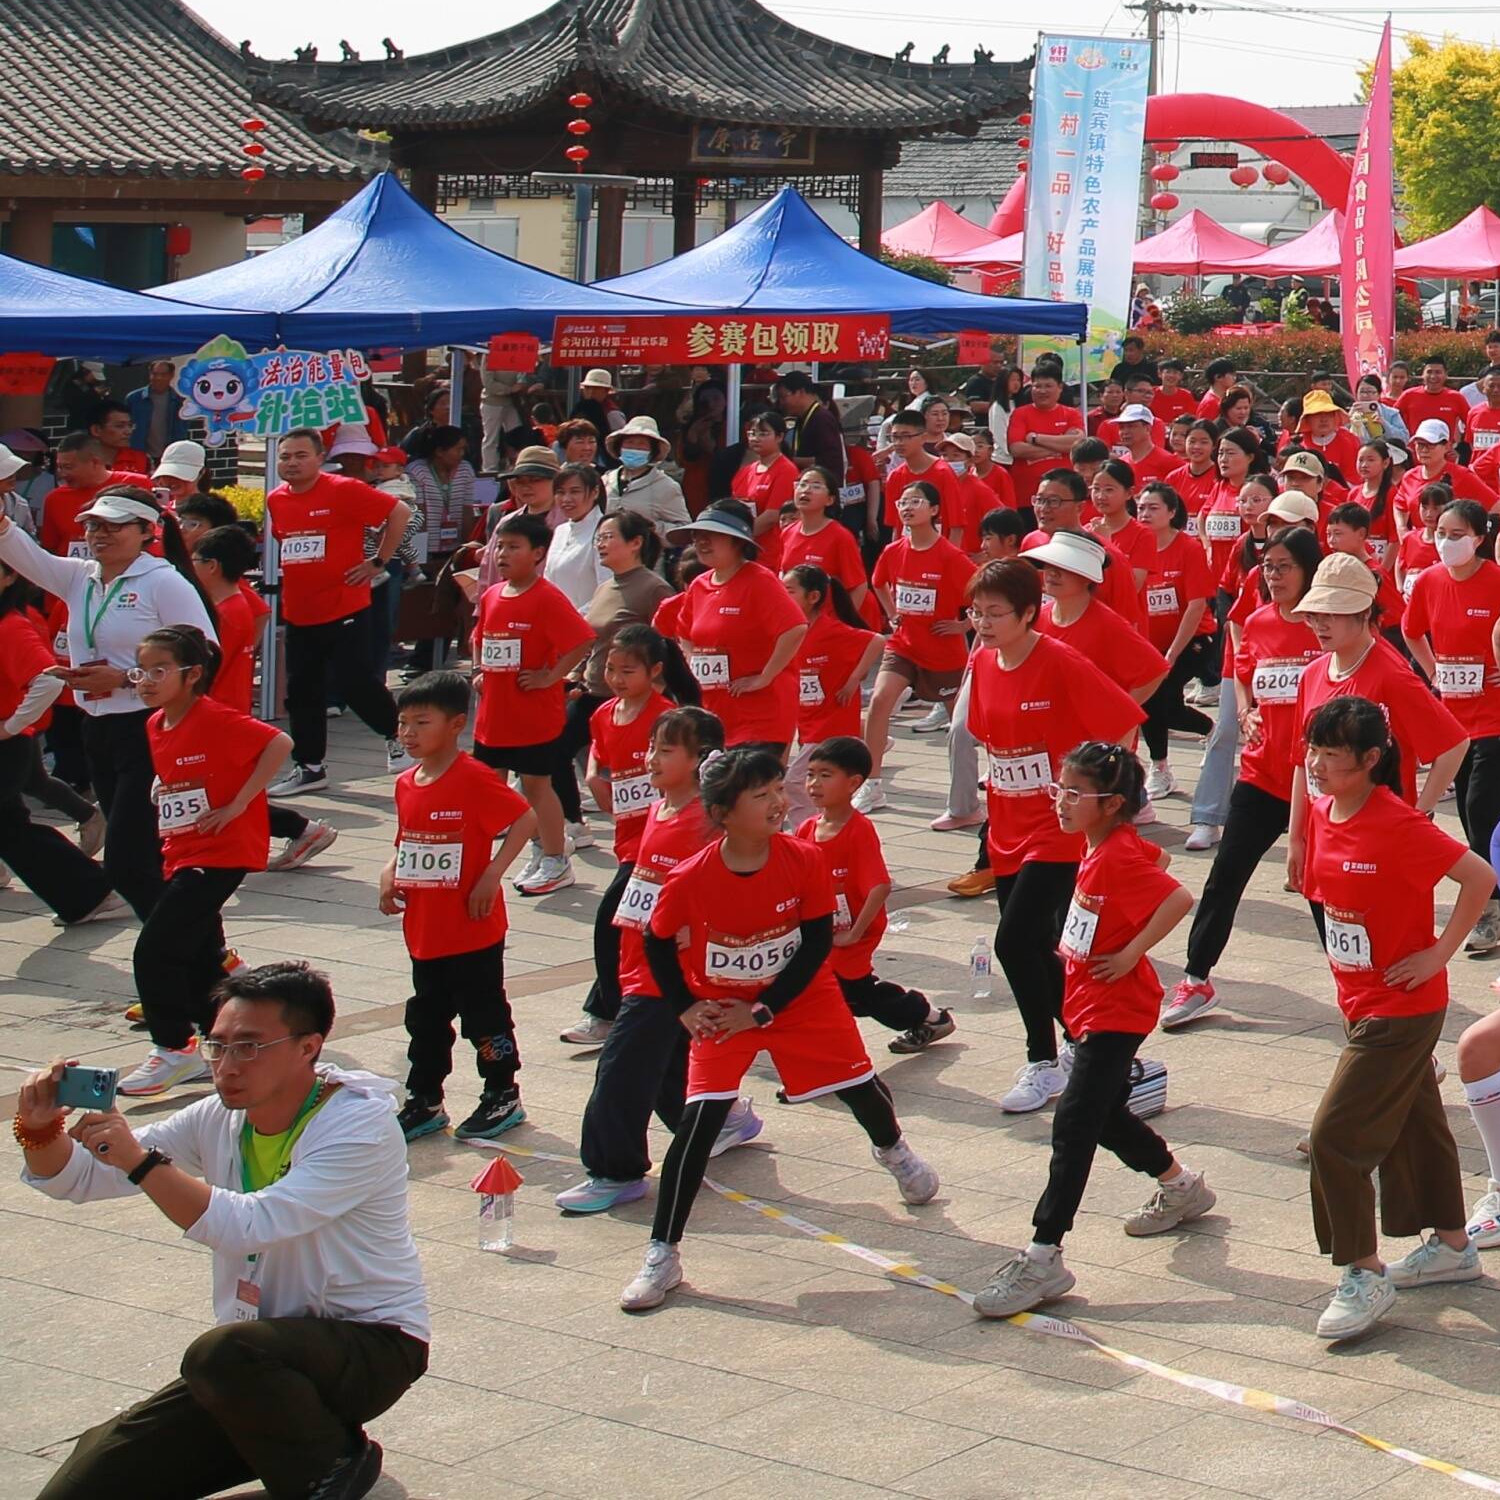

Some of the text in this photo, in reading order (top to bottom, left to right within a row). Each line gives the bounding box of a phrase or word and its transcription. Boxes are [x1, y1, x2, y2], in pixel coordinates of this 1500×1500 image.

[686, 321, 841, 358] 参赛包领取
[260, 352, 369, 388] 法治能量包
[256, 383, 365, 434] 补给站
[162, 797, 200, 820] 035
[710, 939, 795, 971] D4056
[1328, 928, 1363, 956] 061
